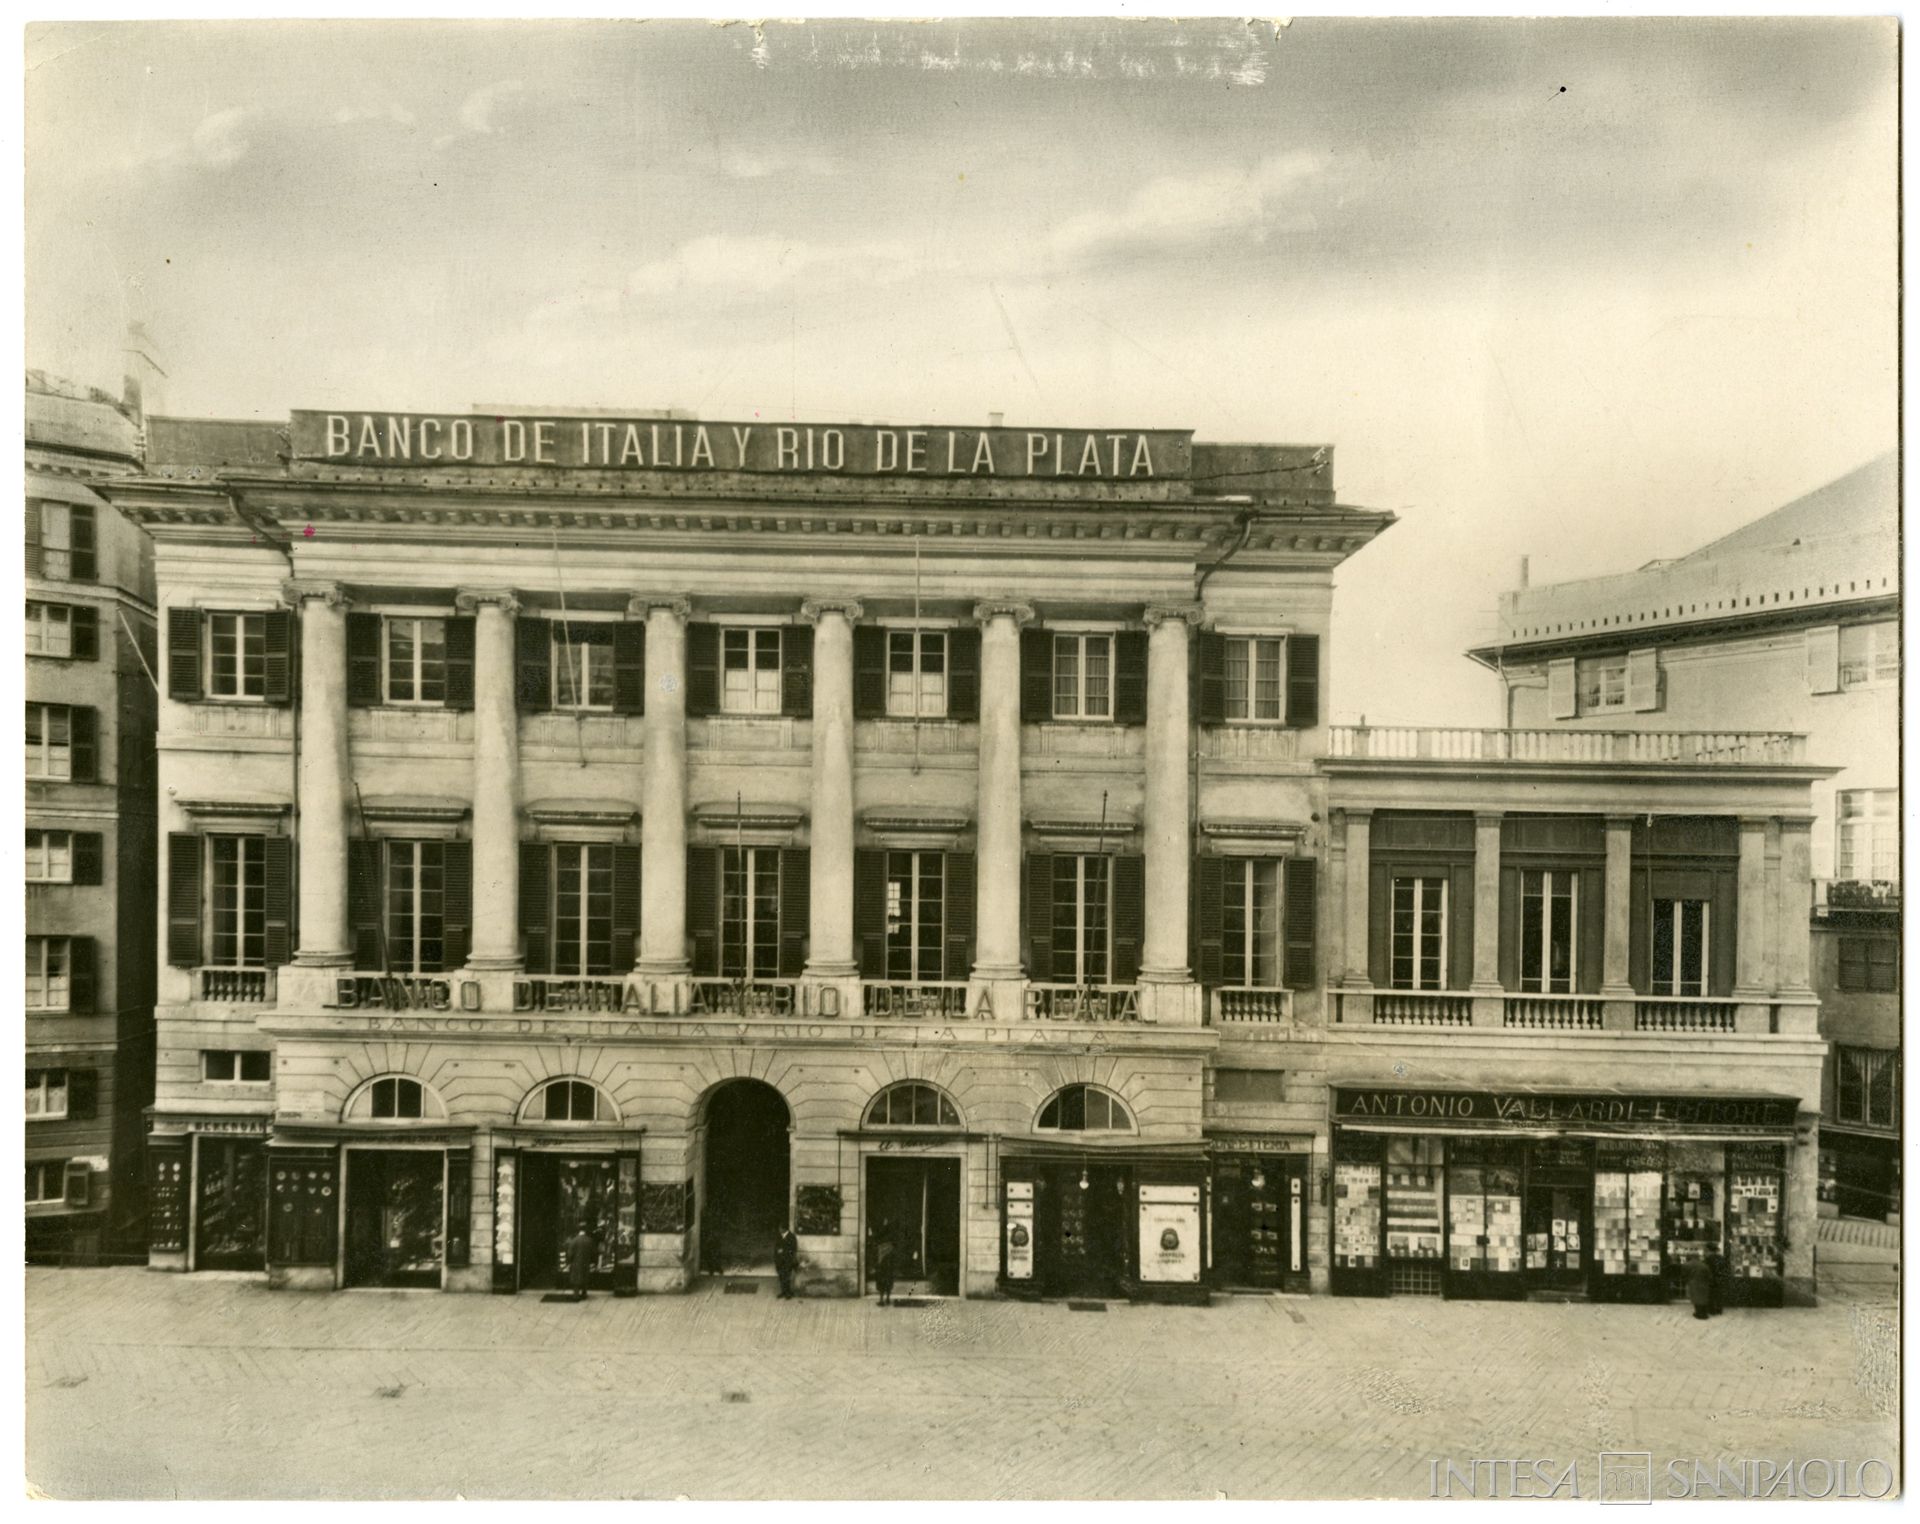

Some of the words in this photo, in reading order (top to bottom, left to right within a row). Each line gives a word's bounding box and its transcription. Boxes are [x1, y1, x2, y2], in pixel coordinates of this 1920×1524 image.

[327, 414, 474, 460] BANCO
[503, 420, 556, 464] DE
[581, 422, 716, 468] ITALIA
[732, 426, 752, 469] Y
[776, 427, 845, 470] RIO
[876, 429, 928, 473] DE
[947, 431, 995, 474] LA
[1026, 433, 1154, 477] PLATA
[336, 976, 481, 1011] BANCO
[512, 979, 566, 1013] DE
[772, 983, 840, 1018] RIO
[872, 985, 923, 1018] DE
[951, 986, 997, 1021] LA
[1022, 987, 1145, 1022] PLATA
[366, 1016, 485, 1033] BANCO
[516, 1019, 553, 1035] DE
[586, 1020, 712, 1038] ITALIA
[773, 1024, 824, 1039] RIO
[850, 1025, 890, 1040] DE
[913, 1026, 958, 1041] LA
[983, 1027, 1111, 1043] PLATA
[1350, 1094, 1475, 1118] ANTONIO
